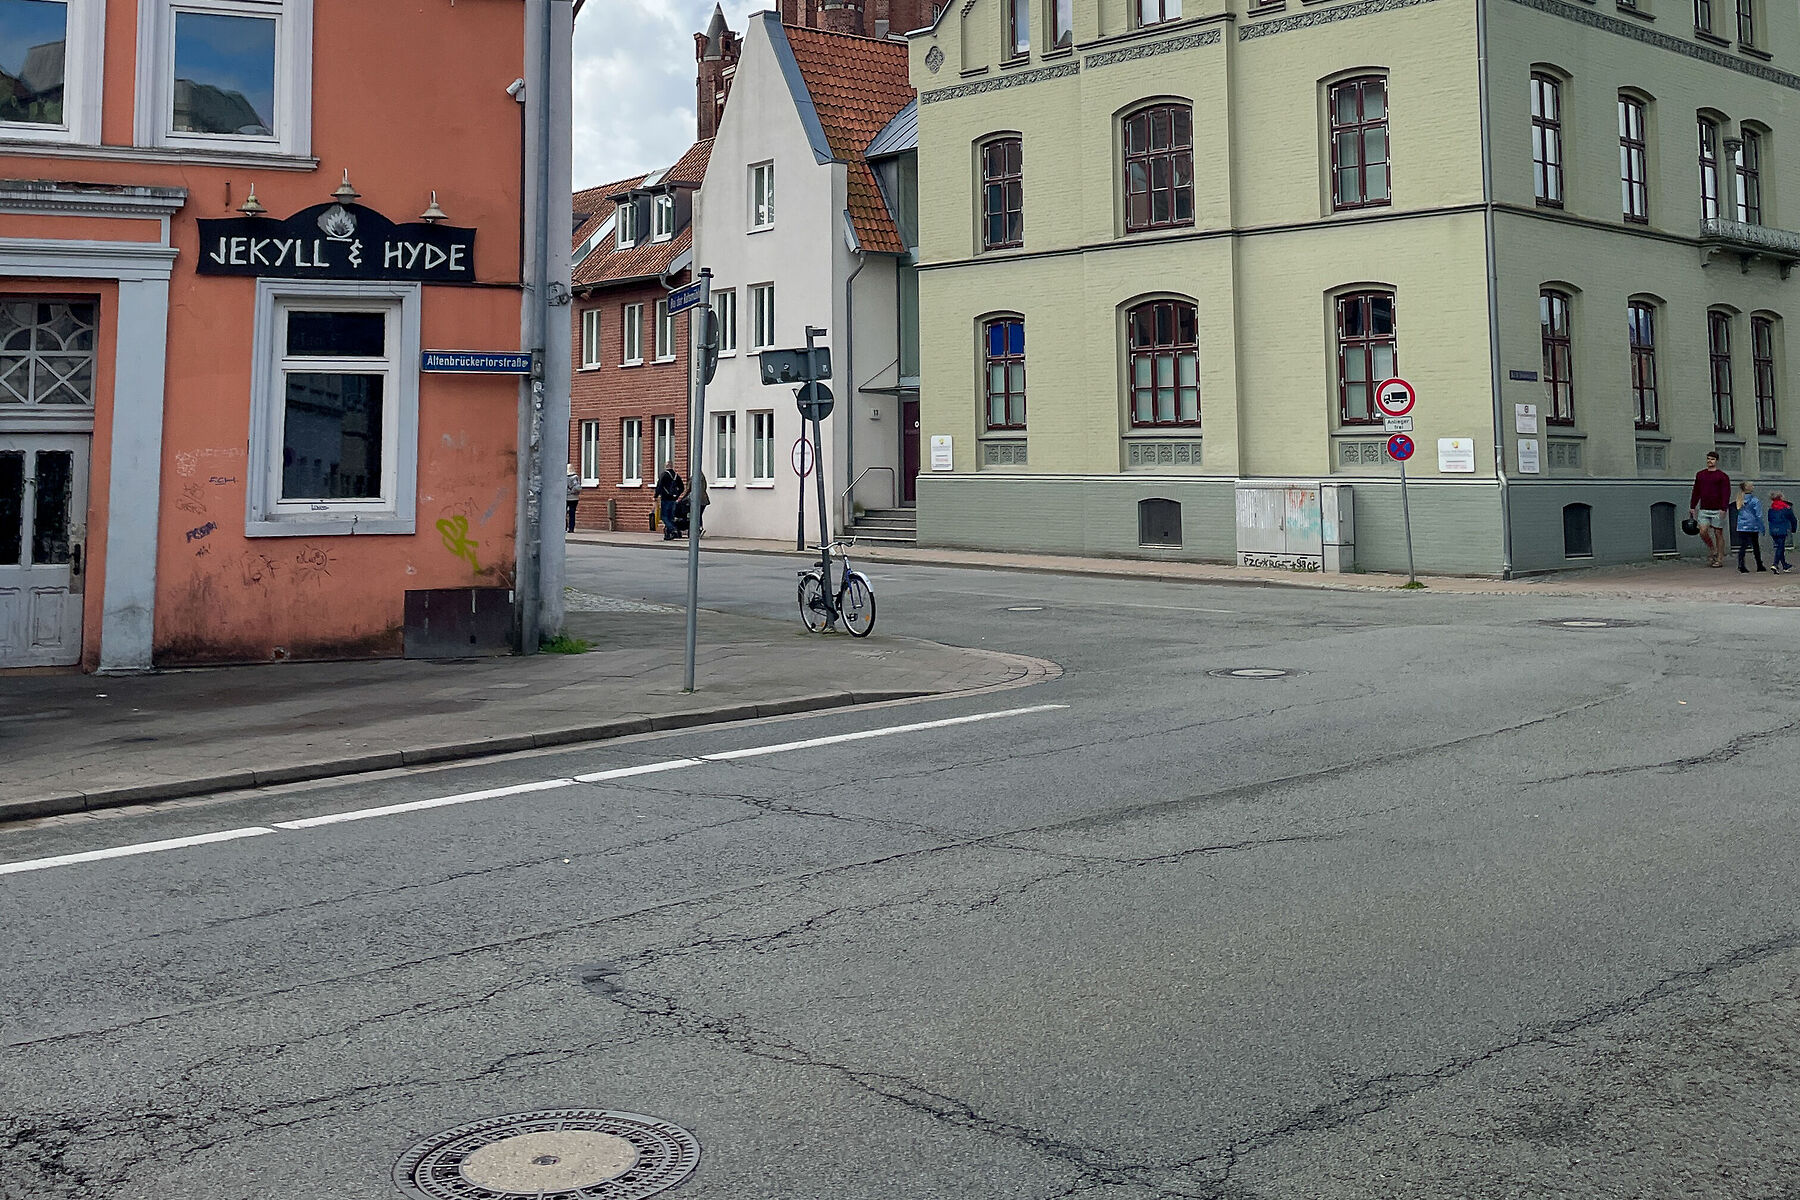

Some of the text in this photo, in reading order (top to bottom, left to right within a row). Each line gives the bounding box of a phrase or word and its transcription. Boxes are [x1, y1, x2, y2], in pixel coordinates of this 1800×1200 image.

[210, 237, 466, 271] JEKYLL & HYDE
